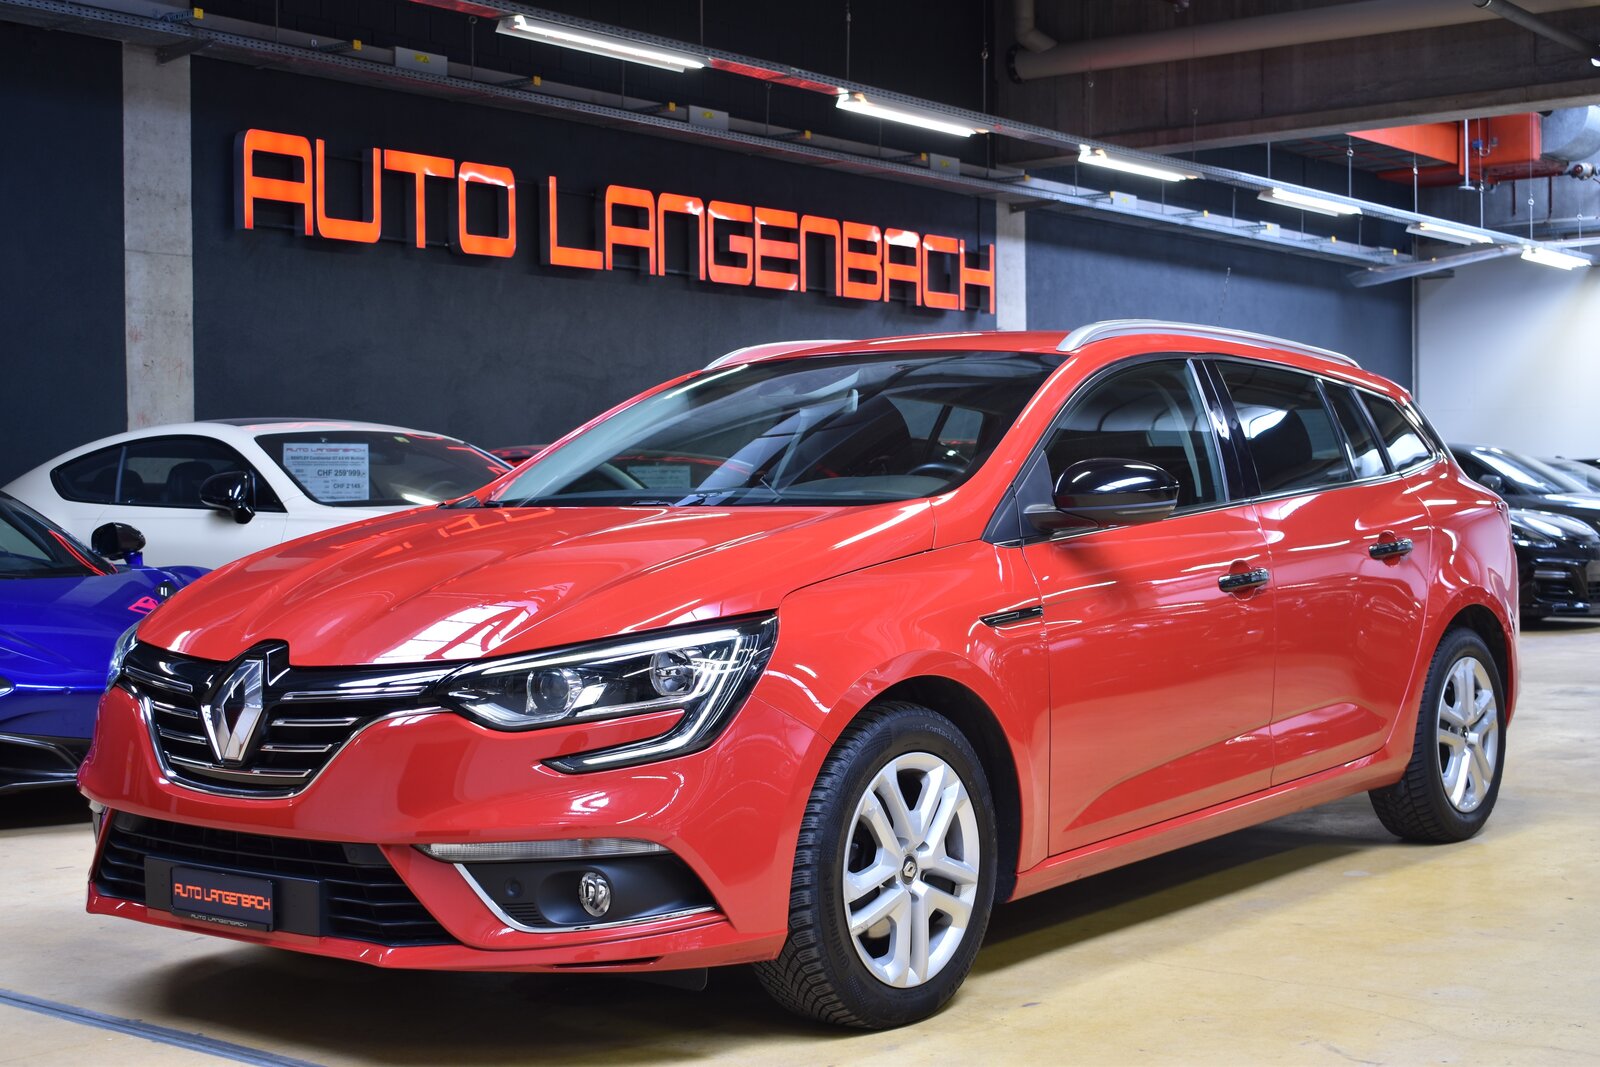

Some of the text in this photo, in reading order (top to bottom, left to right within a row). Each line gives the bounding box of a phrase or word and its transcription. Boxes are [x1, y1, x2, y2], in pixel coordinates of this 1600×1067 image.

[243, 128, 996, 315] AUTO LANGENBACH
[317, 469, 333, 477] CHF
[174, 883, 271, 911] AUTO LANGENBACH
[190, 913, 248, 928] AUTO LANGENBACH
